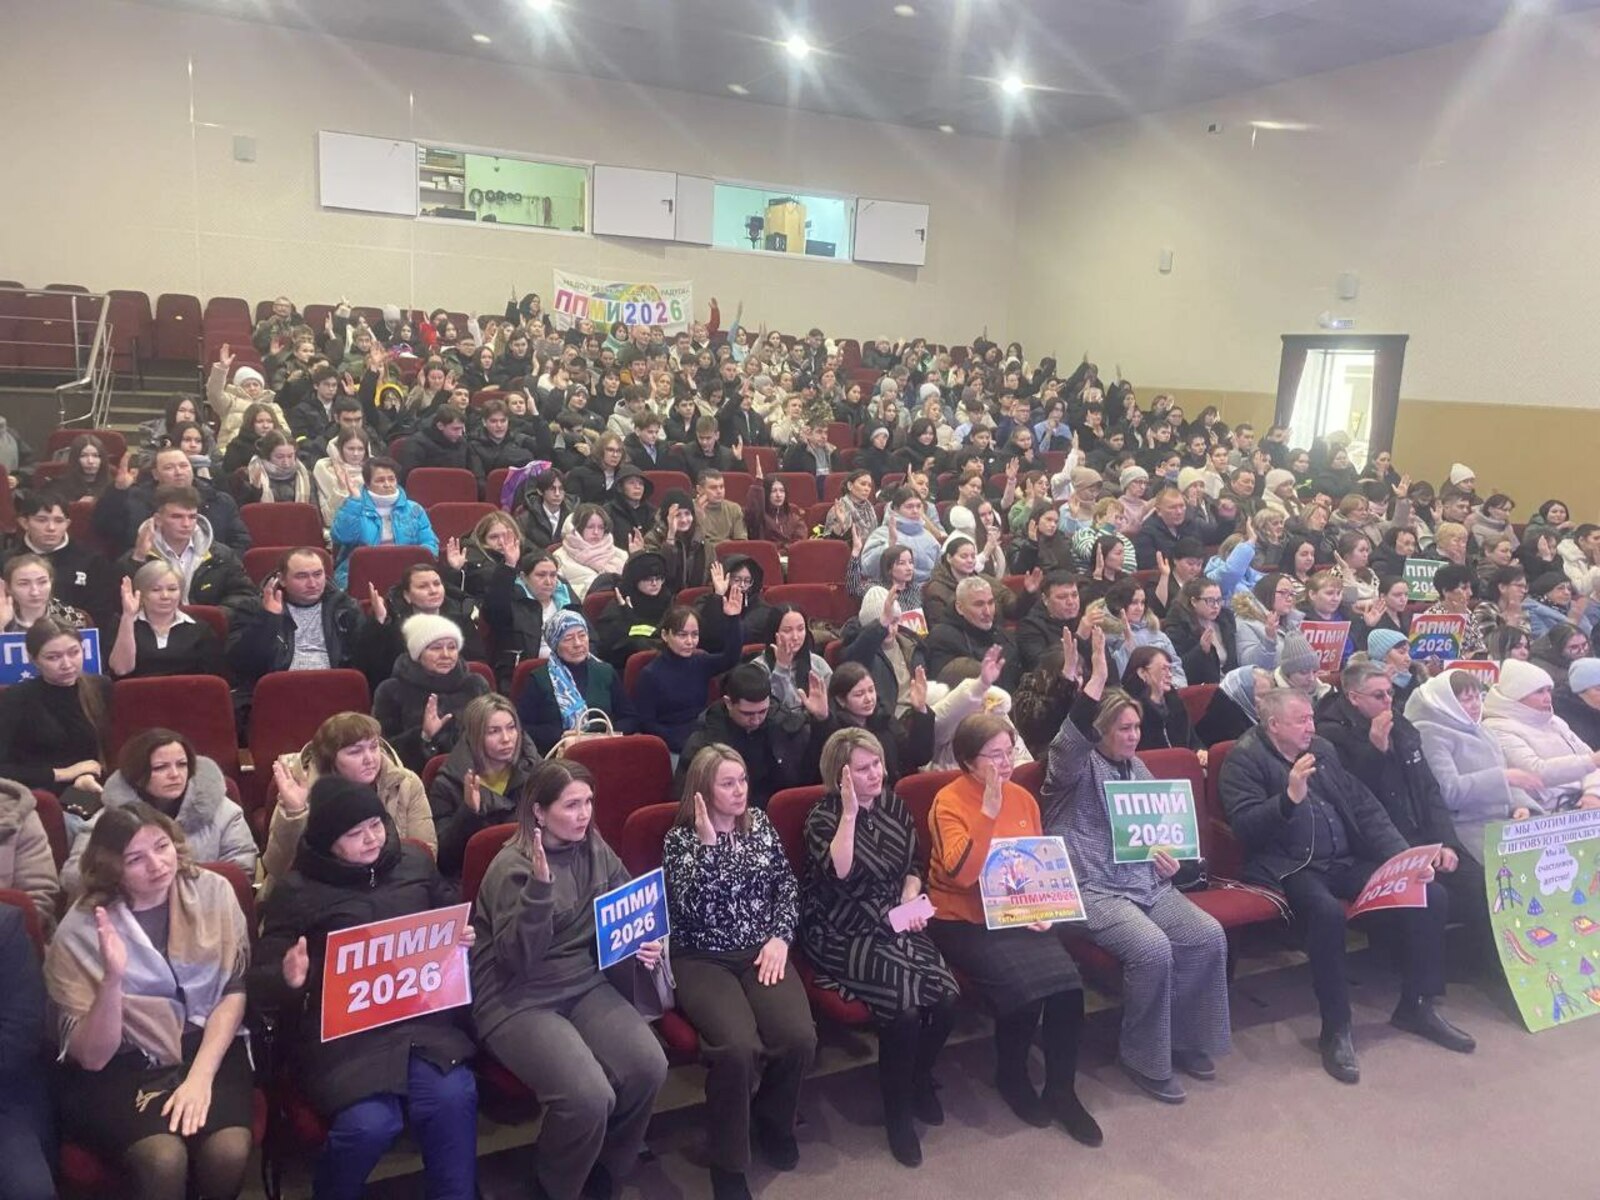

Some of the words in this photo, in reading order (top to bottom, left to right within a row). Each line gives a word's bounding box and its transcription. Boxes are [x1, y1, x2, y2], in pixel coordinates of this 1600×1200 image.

[1405, 564, 1439, 577] ППМ
[1303, 629, 1345, 643] ППМИ
[1416, 620, 1461, 634] ППМИ
[1417, 638, 1453, 652] 2026
[1315, 649, 1336, 663] 026
[1113, 792, 1188, 815] ППМИ
[1127, 823, 1184, 847] 2026
[1514, 824, 1531, 835] МЫ
[1534, 817, 1566, 830] ХОТИМ
[600, 881, 659, 928] ППМИ
[609, 911, 656, 952] 2026
[336, 919, 456, 975] ППМИ
[347, 960, 442, 1014] 2026
